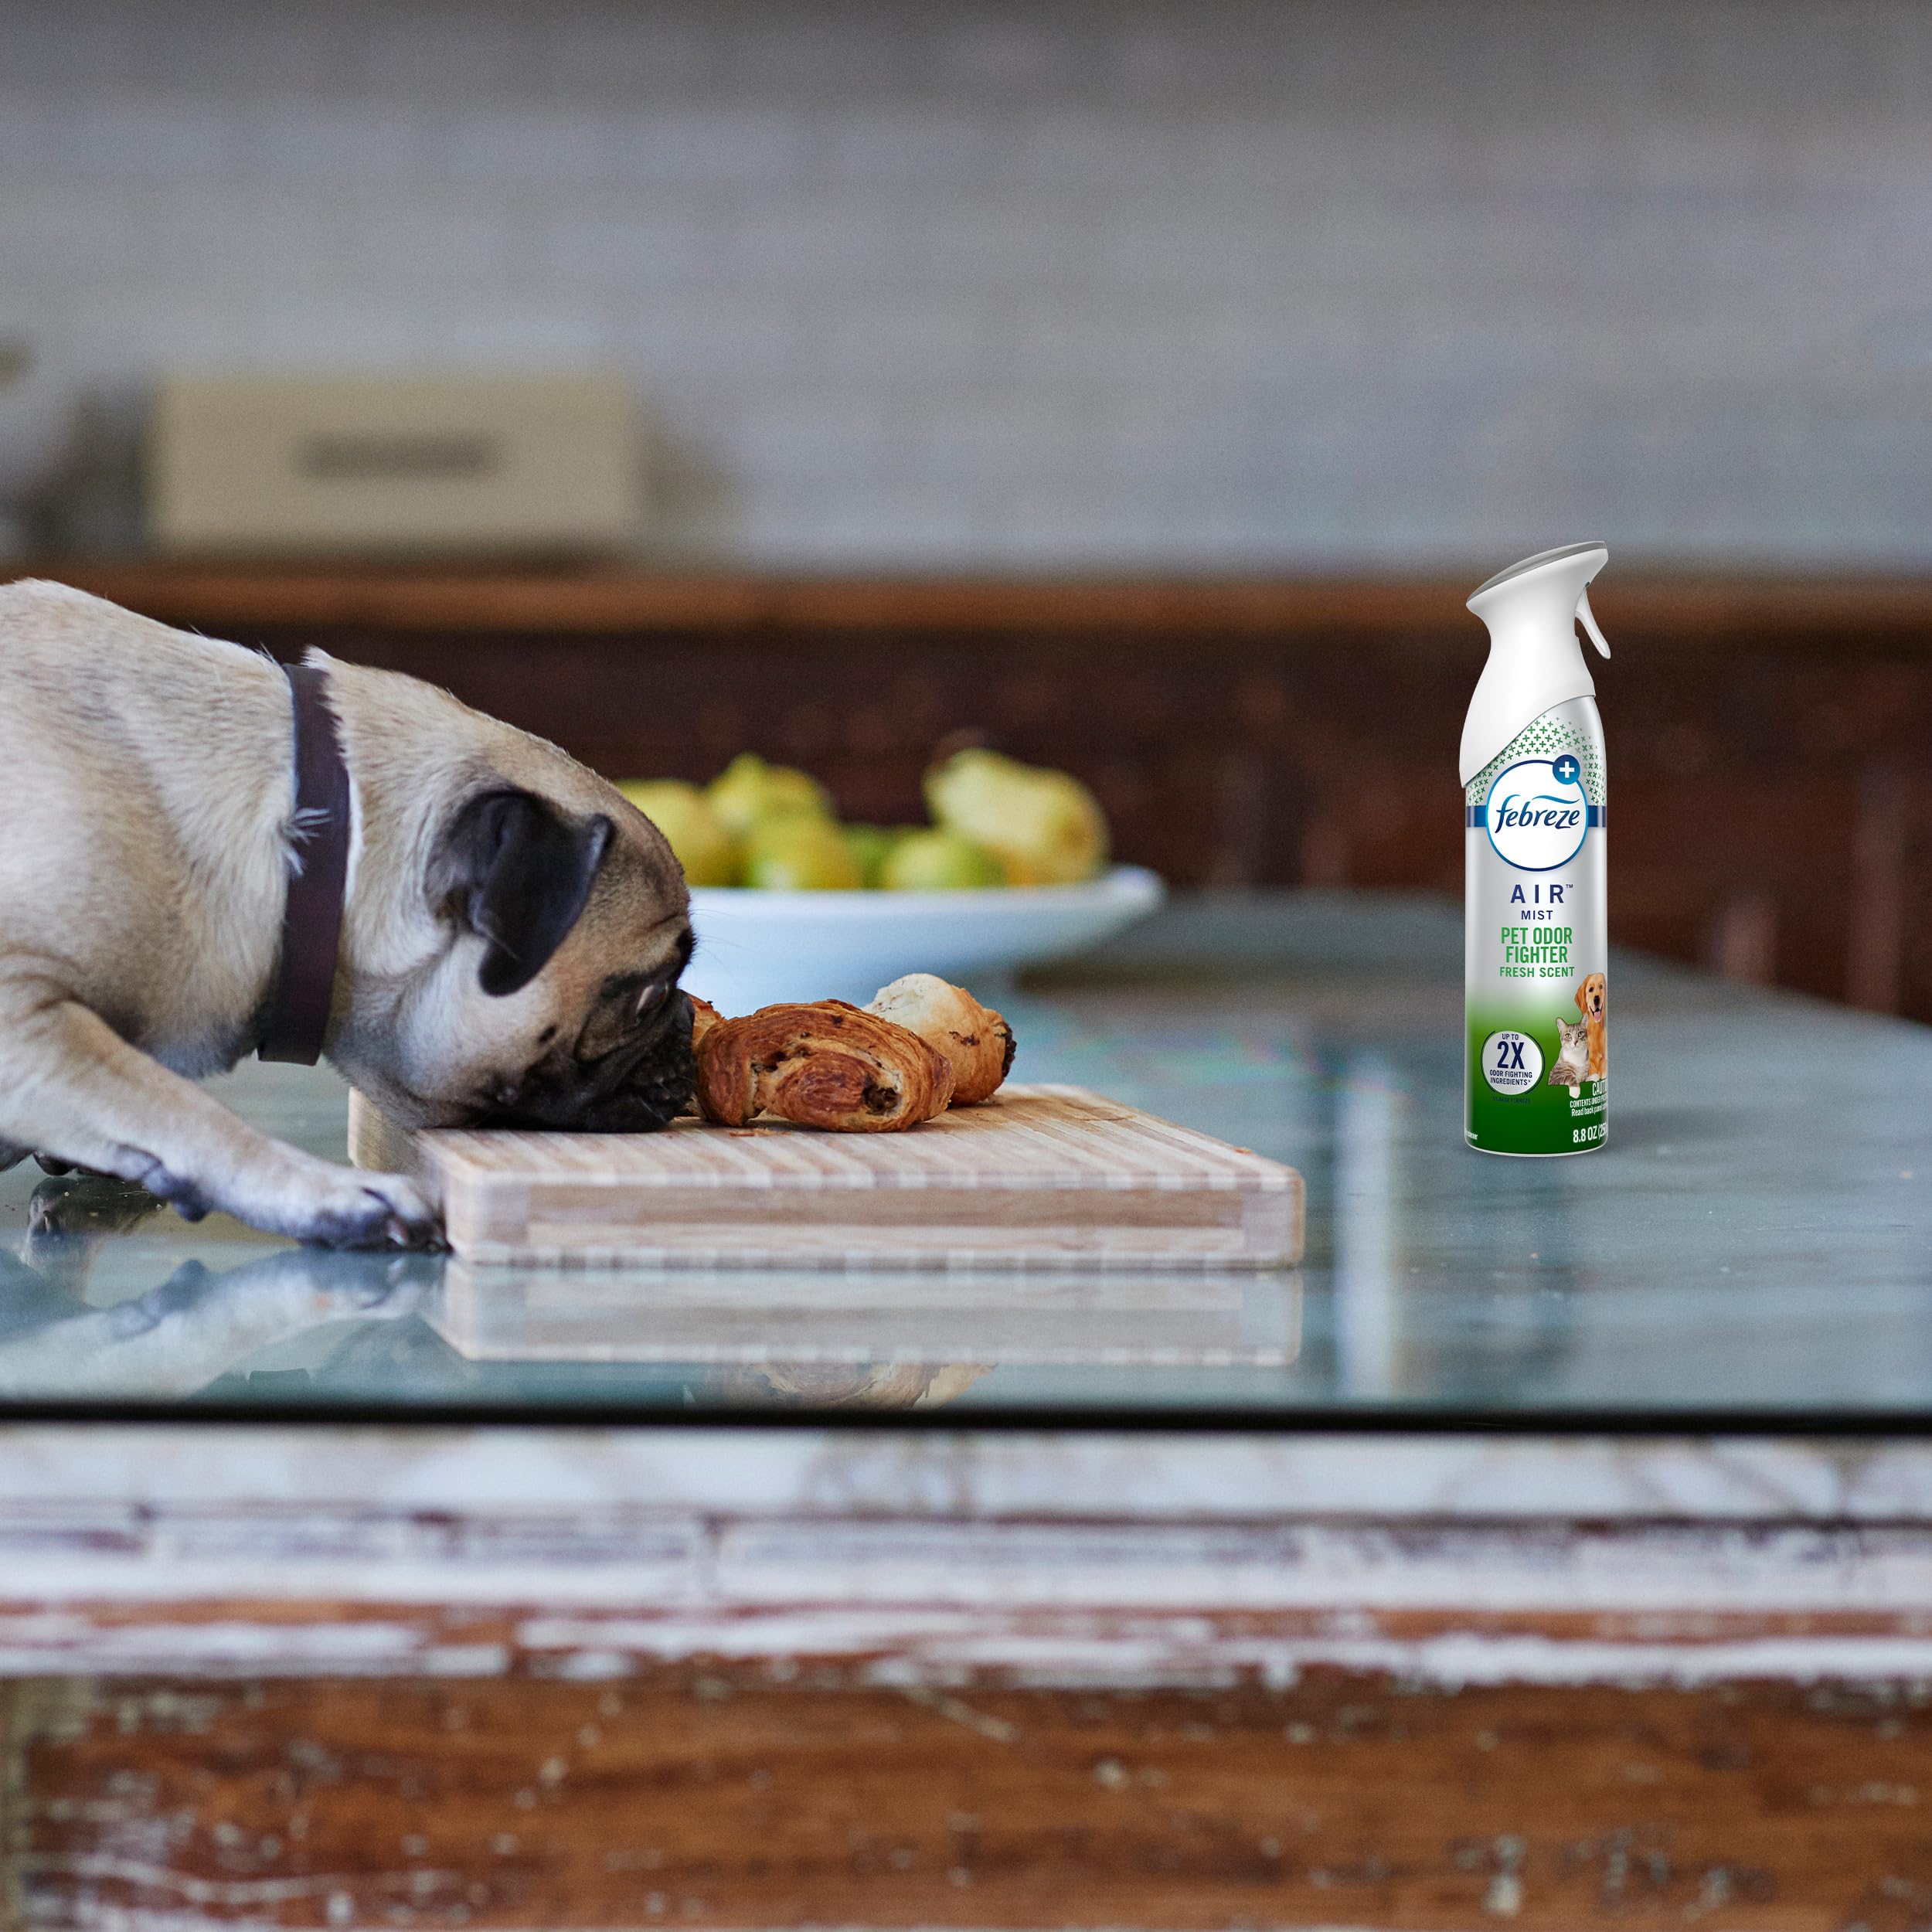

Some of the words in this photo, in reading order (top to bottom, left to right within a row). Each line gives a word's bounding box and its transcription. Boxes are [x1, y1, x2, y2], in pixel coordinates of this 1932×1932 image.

[1495, 794, 1580, 834] febreze
[1521, 910, 1553, 920] MIST
[1501, 927, 1529, 944] PET
[1532, 927, 1573, 944] ODOR
[1505, 946, 1568, 964] FIGHTER
[1499, 967, 1535, 978] FRESH
[1539, 967, 1575, 978] SCENT
[1497, 1041, 1525, 1070] 2X
[1570, 1098, 1591, 1108] CONTENTS
[1573, 1128, 1587, 1143] 8.8
[1587, 1125, 1598, 1141] OZ
